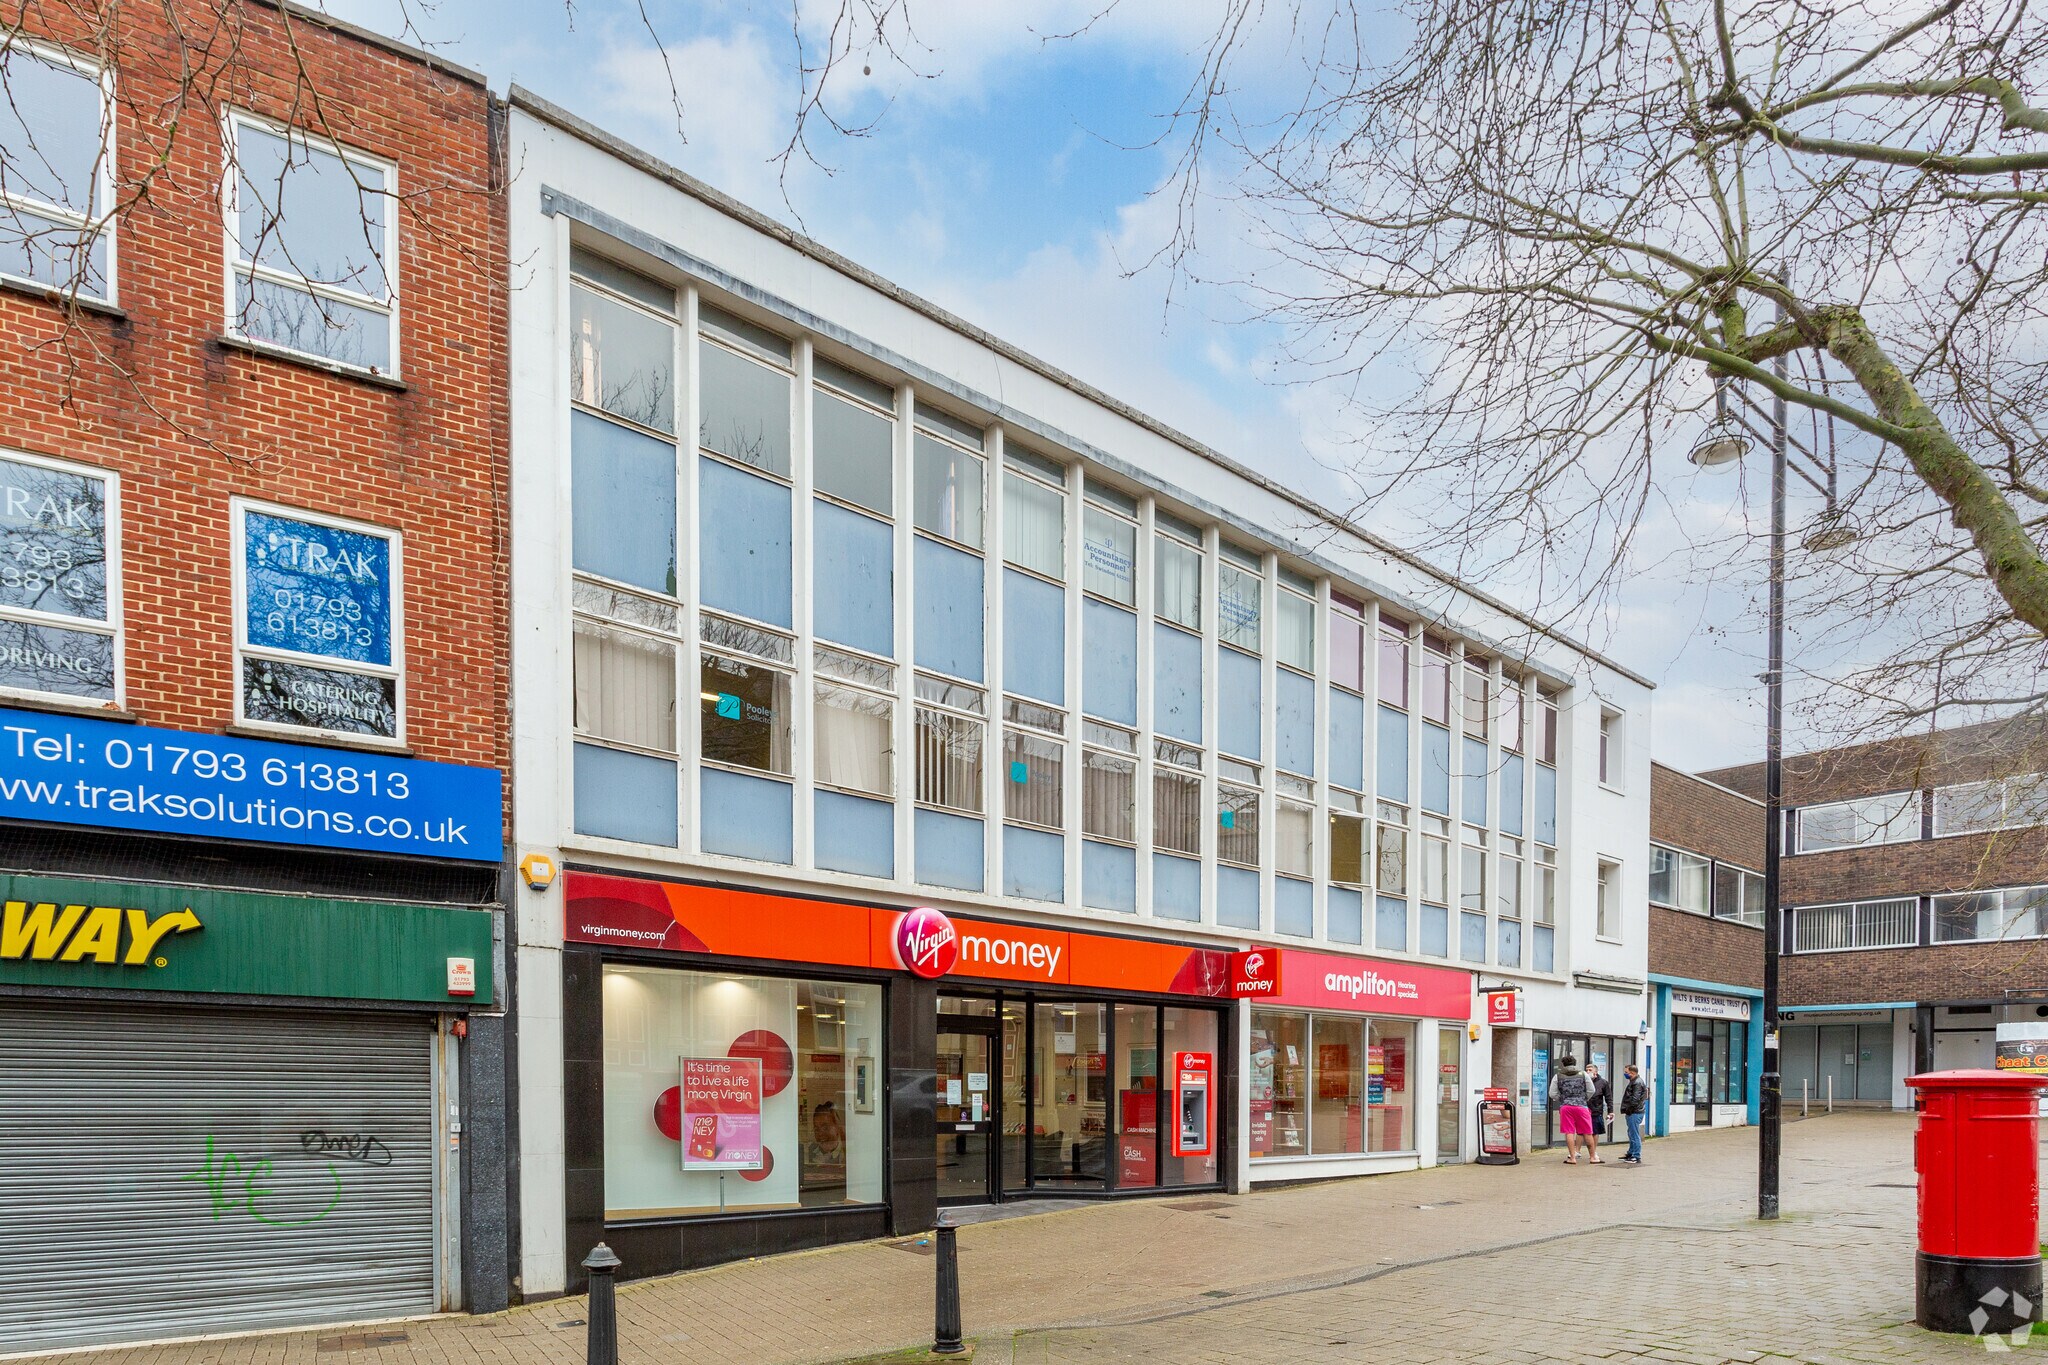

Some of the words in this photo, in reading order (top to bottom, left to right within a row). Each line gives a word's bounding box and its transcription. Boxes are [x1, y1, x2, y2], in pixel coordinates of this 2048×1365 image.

[0, 486, 91, 531] RAK
[283, 535, 379, 581] TRAK
[1084, 542, 1131, 568] Accountancy
[1090, 552, 1126, 572] Personnel
[275, 589, 362, 621] 01793
[267, 611, 372, 646] 613813
[290, 680, 380, 705] CATERING
[279, 695, 389, 723] HOSPITALITY
[746, 702, 777, 718] Pooley
[4, 725, 86, 764] Tel:
[105, 738, 247, 782] 01793
[262, 757, 410, 800] 613813
[580, 923, 666, 941] virginmoney.com
[905, 914, 954, 969] Virgin
[962, 935, 1062, 977] money
[1236, 980, 1273, 992] money
[1324, 970, 1397, 1000] amplifon
[1397, 980, 1417, 991] Hearing
[1672, 992, 1687, 1002] WILTS
[1689, 995, 1693, 1003] &
[1694, 995, 1710, 1005] BERKS
[1711, 997, 1726, 1007] CANAL
[1727, 999, 1741, 1008] TRUST
[687, 1061, 705, 1073] It's
[705, 1062, 731, 1073] time
[2034, 1054, 2048, 1067] C
[687, 1075, 700, 1086] to
[701, 1075, 722, 1086] live
[723, 1078, 731, 1087] a
[732, 1076, 750, 1087] life
[687, 1090, 719, 1099] more
[720, 1089, 752, 1102] Virgin
[1123, 1149, 1141, 1158] CASH
